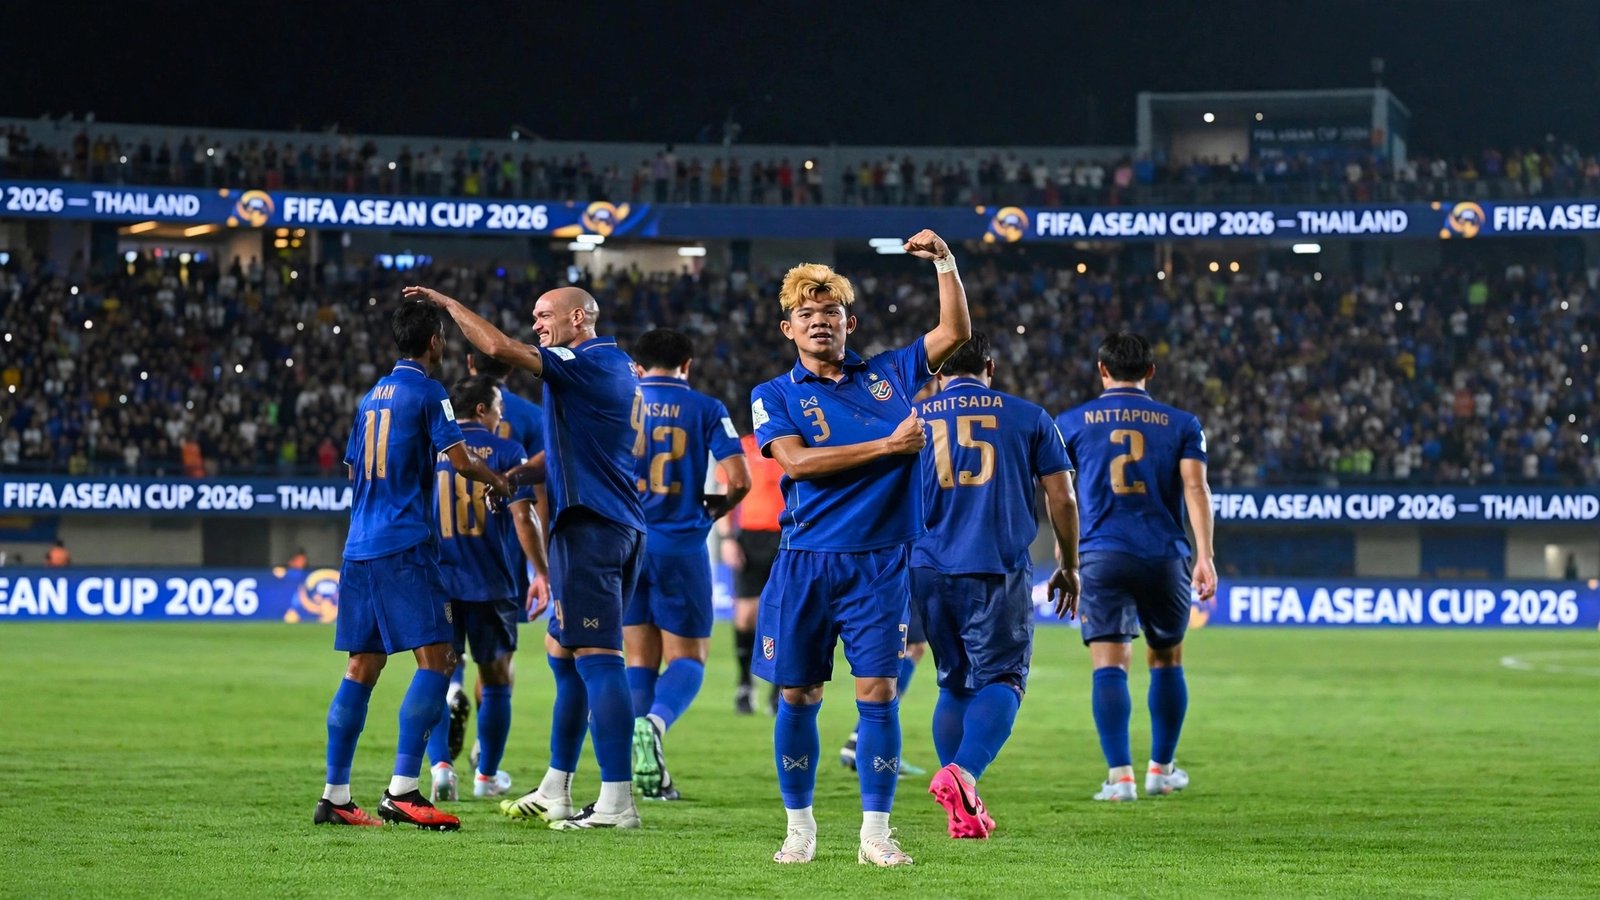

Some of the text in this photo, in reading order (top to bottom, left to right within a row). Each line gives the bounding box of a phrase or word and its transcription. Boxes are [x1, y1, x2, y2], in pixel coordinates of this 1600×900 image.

[7, 186, 64, 213] 2026
[92, 190, 200, 217] THAILAND
[283, 198, 548, 230] FIFA ASEAN CUP 2026
[1493, 204, 1600, 231] FIFA ASE
[1036, 212, 1087, 236] FIFA
[1088, 212, 1167, 236] ASEAN
[1169, 212, 1217, 236] CUP
[1219, 211, 1275, 235] 2026
[1297, 209, 1408, 234] THAILAND
[922, 395, 1003, 415] KRITSADA
[1084, 408, 1169, 427] NATTAPONG
[803, 406, 831, 443] 3
[364, 408, 391, 481] 11
[637, 425, 687, 495] 2
[926, 415, 997, 488] 15
[1109, 429, 1147, 495] 2
[4, 483, 57, 508] FIFA
[58, 484, 141, 509] ASEAN
[144, 485, 195, 510] CUP
[197, 485, 254, 510] 2026
[437, 469, 487, 538] 18
[1260, 494, 1342, 520] ASEAN
[1345, 494, 1395, 520] CUP
[1397, 494, 1457, 520] 2026
[1480, 494, 1600, 520] THAILAND
[76, 577, 159, 616] CUP
[164, 577, 260, 616] 2026
[1229, 586, 1579, 625] FIFA ASEAN CUP 2026
